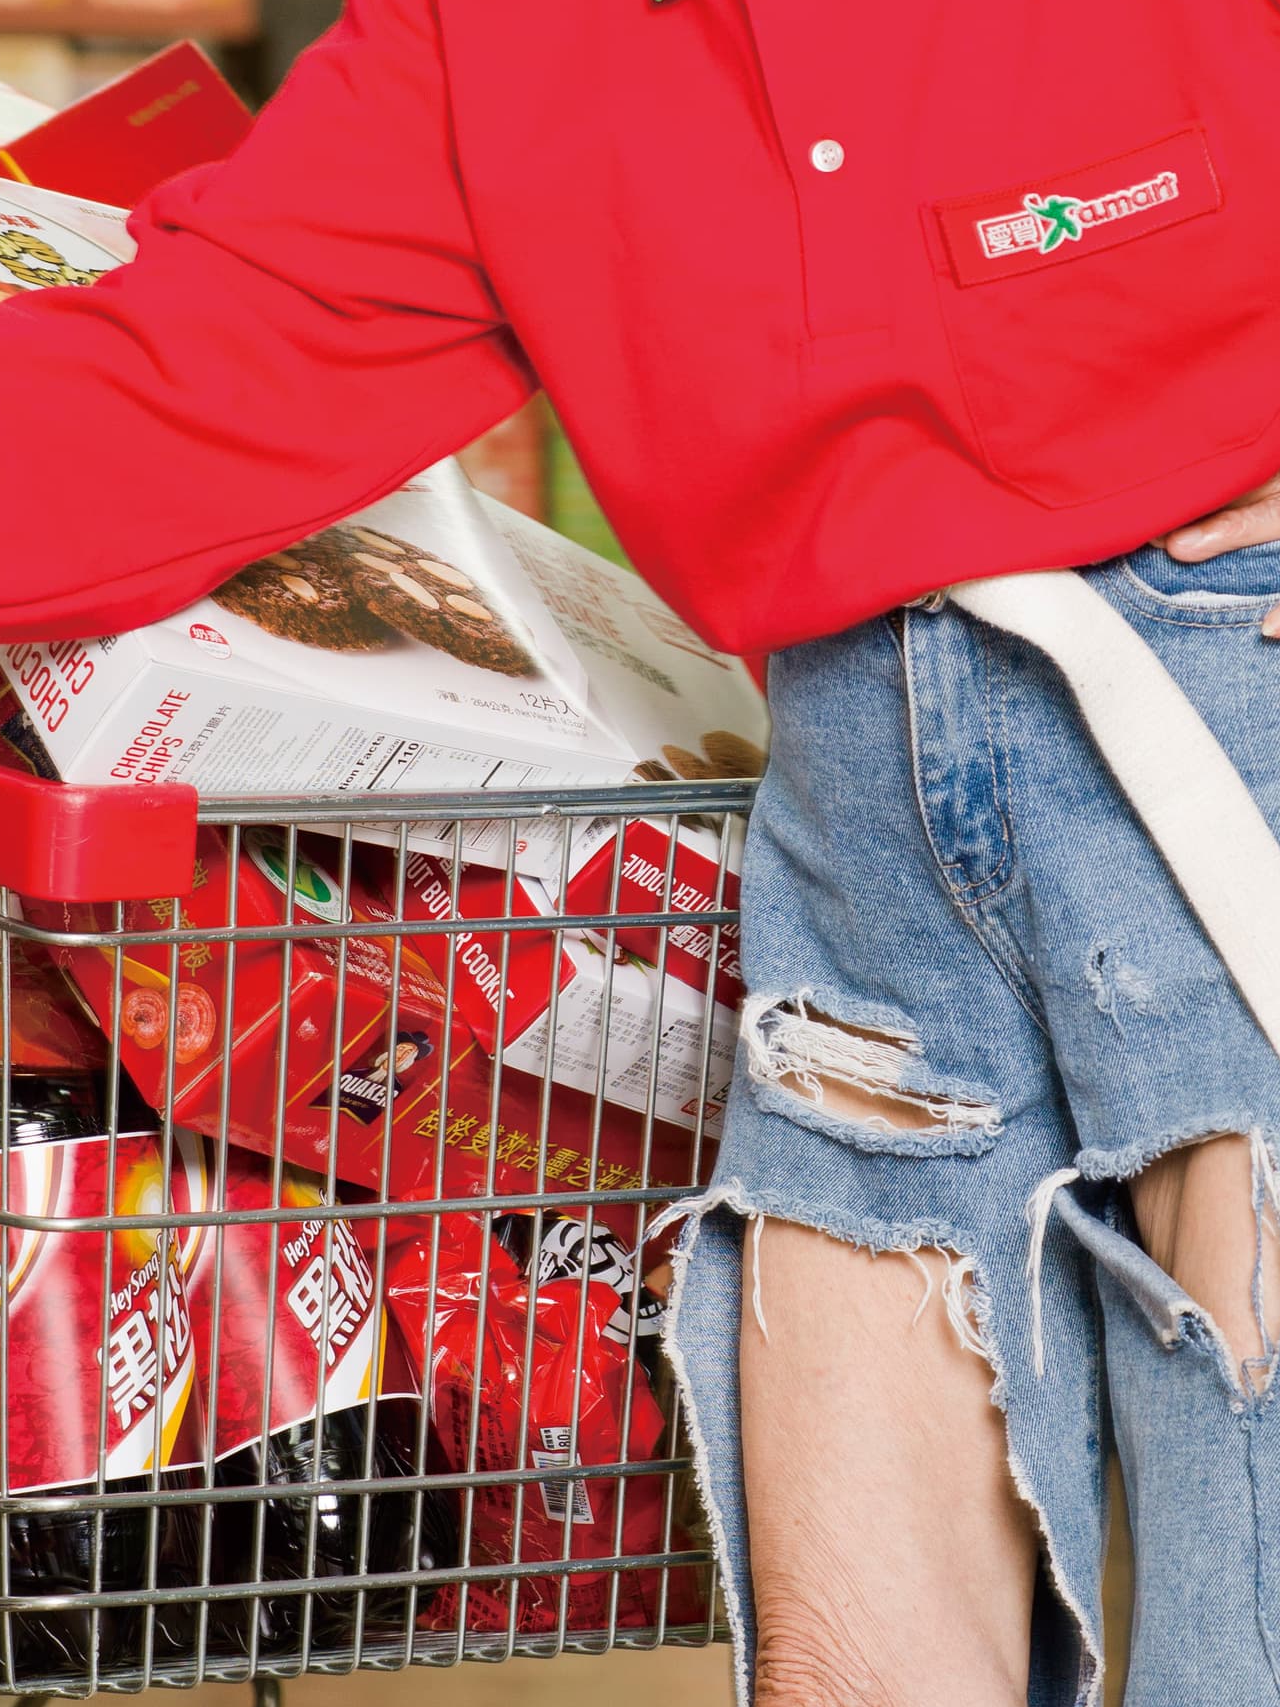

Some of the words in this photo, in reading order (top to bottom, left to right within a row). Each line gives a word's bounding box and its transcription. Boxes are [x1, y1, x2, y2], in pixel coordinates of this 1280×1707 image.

[986, 216, 1040, 254] 愛買
[519, 692, 580, 718] 12片入
[110, 688, 192, 780] CHOCOLATE
[356, 734, 386, 767] Facts
[397, 742, 420, 767] 110
[134, 735, 184, 785] CHIPS
[286, 1216, 375, 1368] 黑松
[98, 1259, 192, 1431] 黑松
